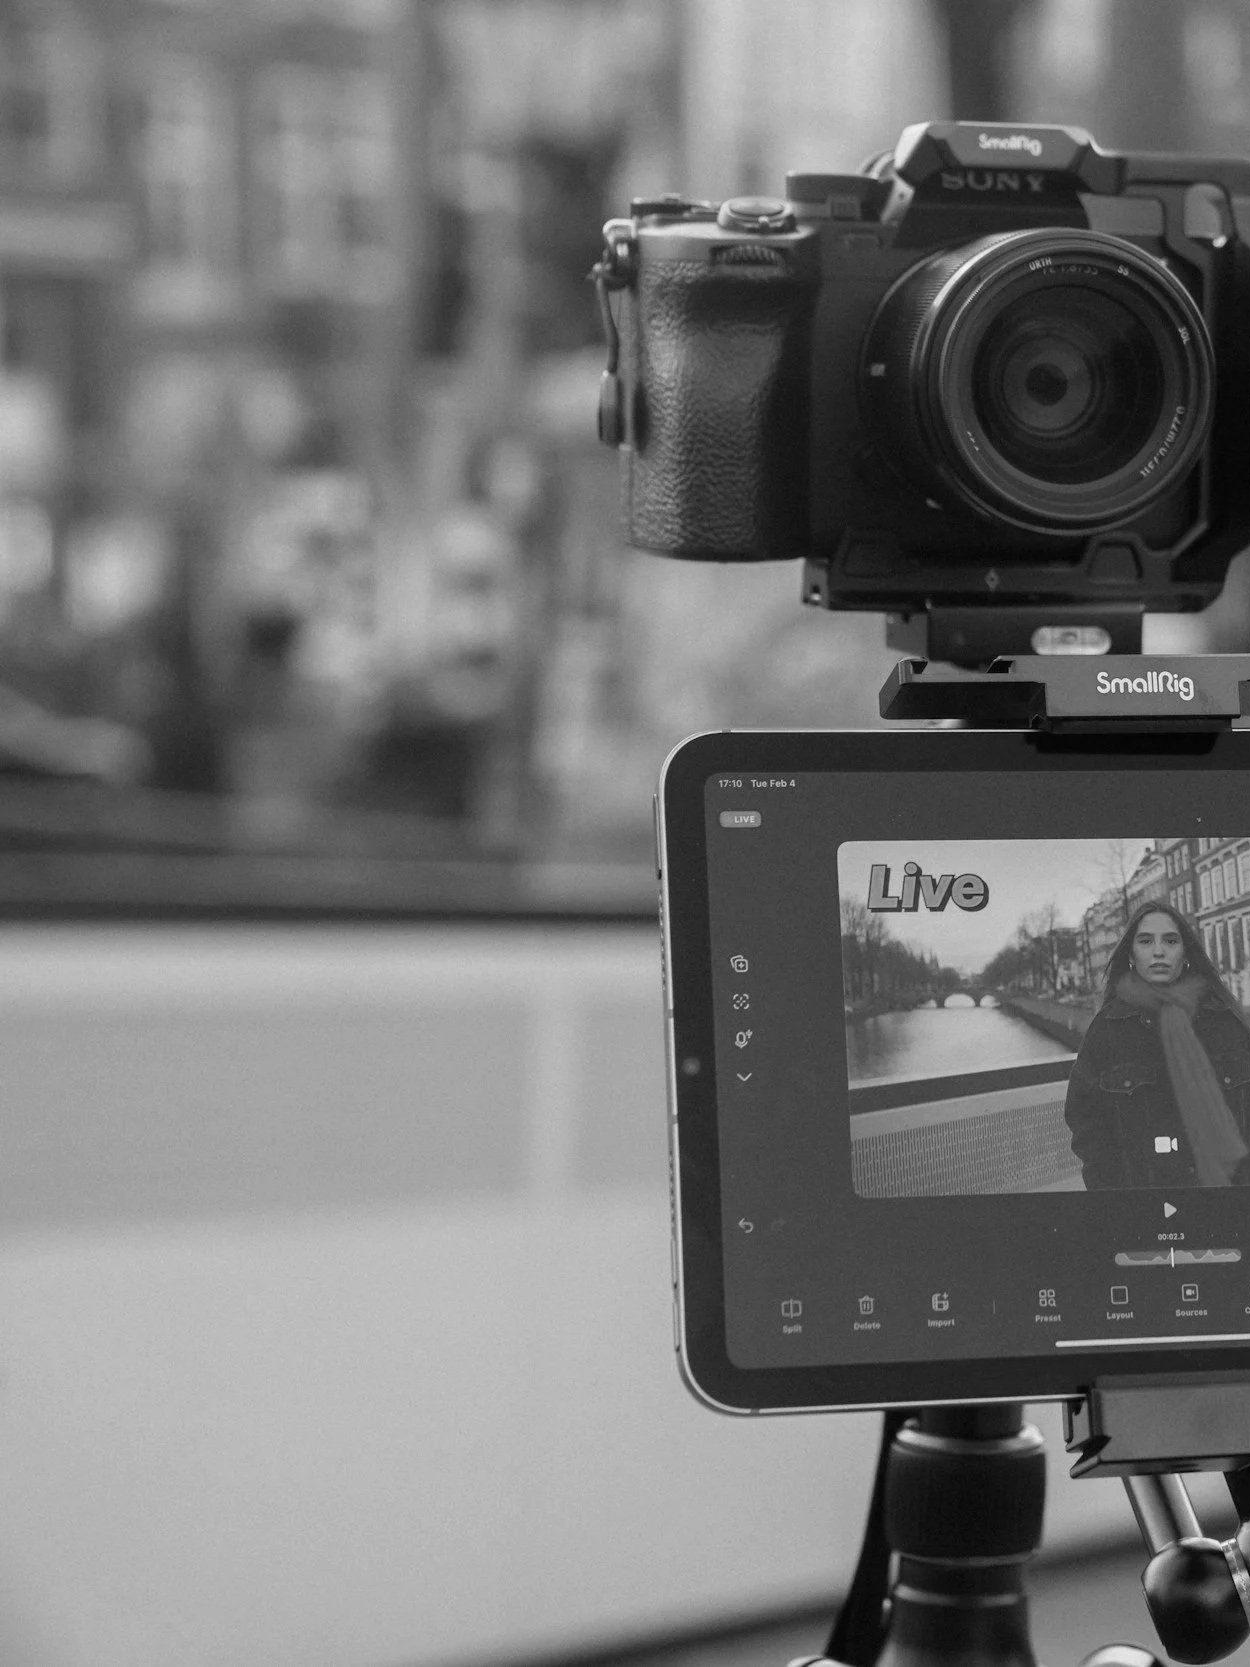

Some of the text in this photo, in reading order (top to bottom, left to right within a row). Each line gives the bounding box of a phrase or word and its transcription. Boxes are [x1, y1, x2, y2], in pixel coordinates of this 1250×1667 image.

[978, 133, 1042, 157] SmallRig
[940, 170, 1043, 192] SONY
[1096, 670, 1195, 701] SmallRig
[718, 779, 796, 788] 17:10 Tue Feb 4
[734, 815, 756, 824] LIVE
[867, 861, 990, 913] Live
[1157, 1232, 1186, 1241] 00:02.3
[1106, 1311, 1134, 1321] Layout
[1175, 1308, 1208, 1317] Sources
[927, 1318, 956, 1329] Import
[1034, 1314, 1062, 1323] Preset
[782, 1324, 802, 1335] Split
[853, 1321, 881, 1331] Delete
